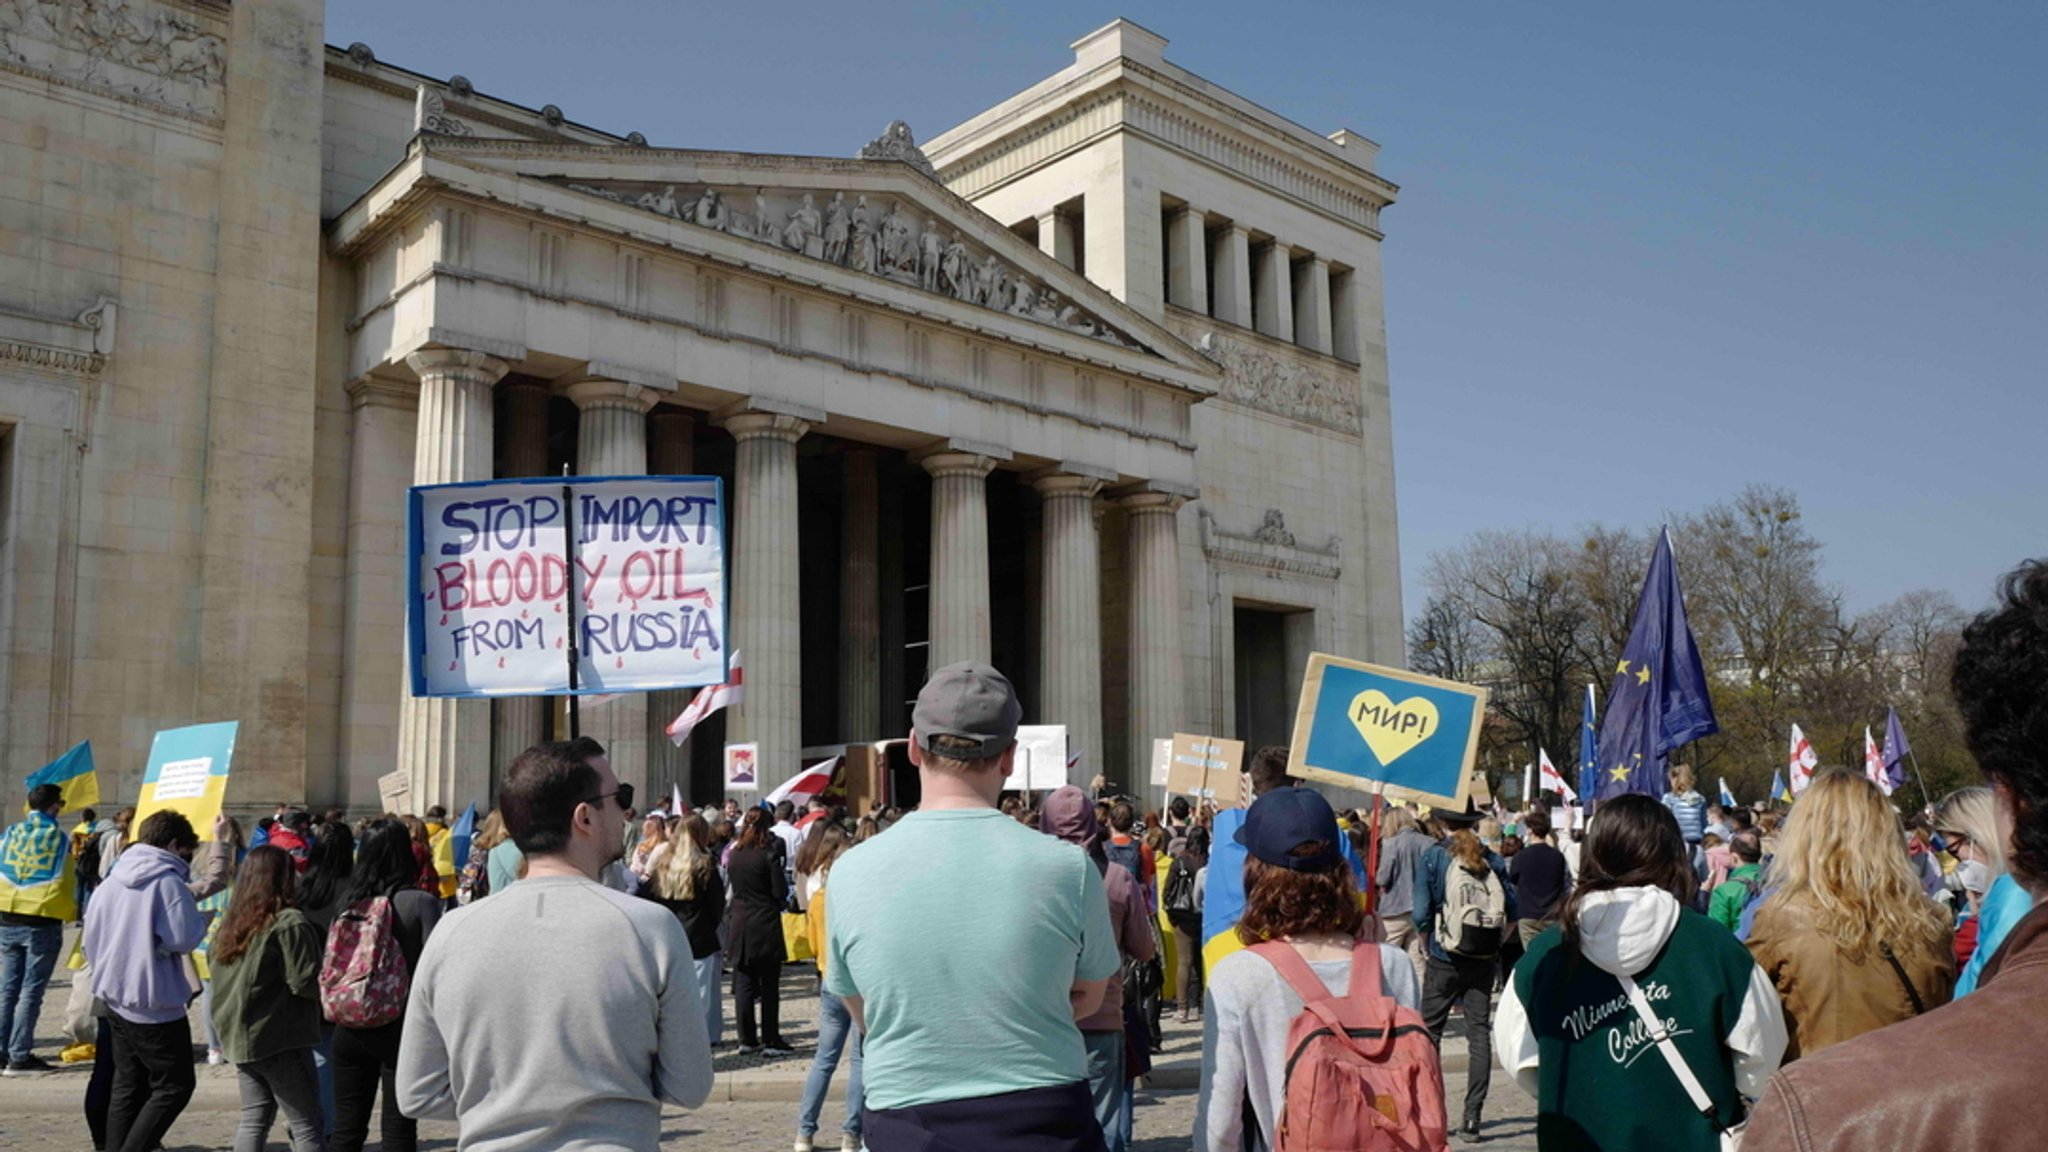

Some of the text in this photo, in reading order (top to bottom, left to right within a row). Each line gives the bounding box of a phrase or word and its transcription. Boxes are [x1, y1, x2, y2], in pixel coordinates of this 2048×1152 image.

[441, 494, 717, 554] STOP IMPORT
[435, 547, 710, 611] BLOODY OIL
[451, 606, 720, 659] FROM RUSSIA
[1357, 702, 1427, 738] МИР!
[1562, 981, 1671, 1040] Minneta
